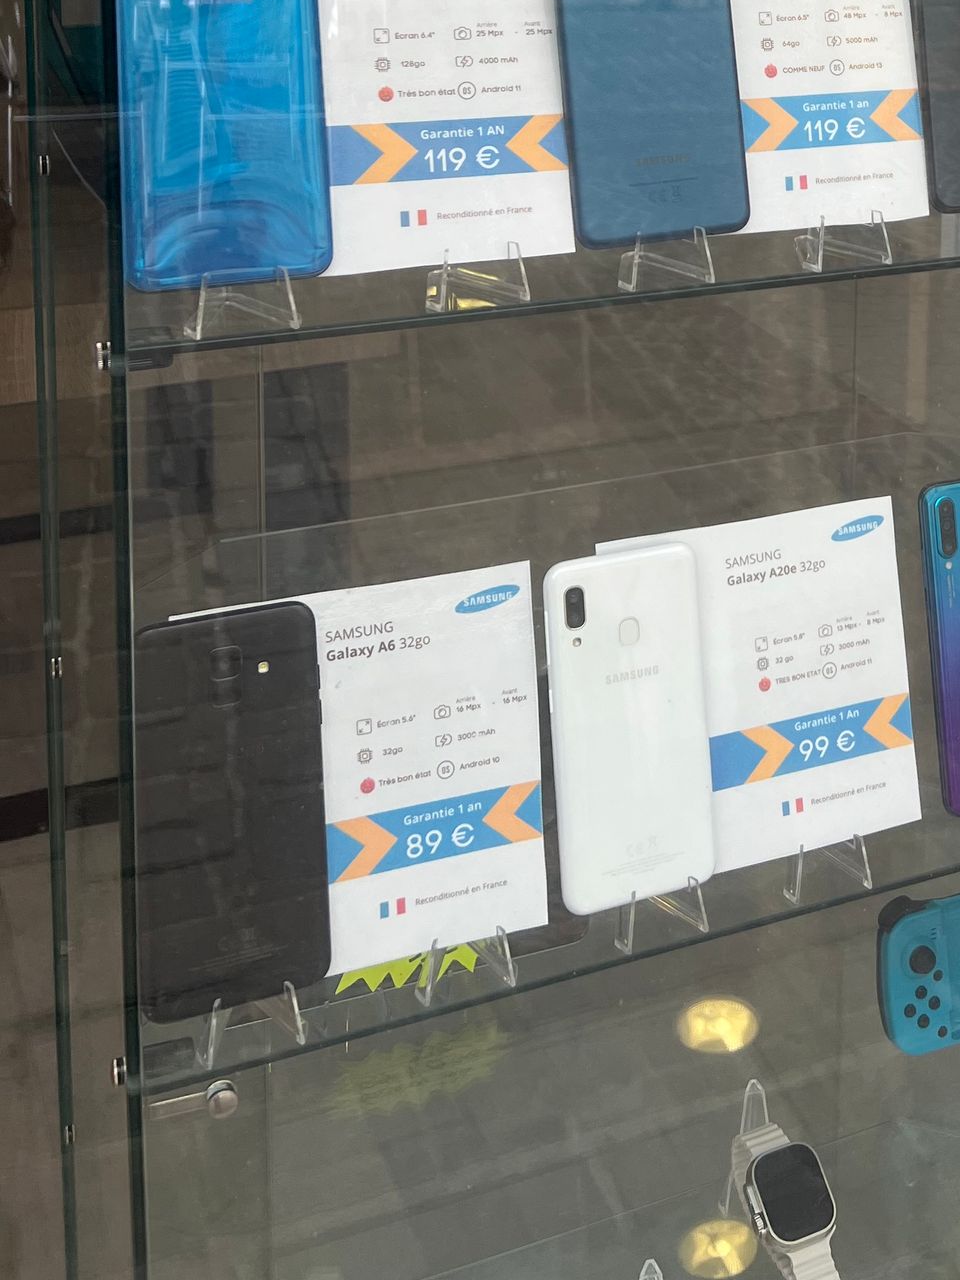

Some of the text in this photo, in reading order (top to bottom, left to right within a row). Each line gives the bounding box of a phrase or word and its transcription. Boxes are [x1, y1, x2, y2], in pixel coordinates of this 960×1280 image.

[802, 100, 869, 113] Garantie 1 an
[420, 125, 505, 140] Garantie 1 AN
[803, 117, 866, 142] 119 €
[424, 145, 500, 173] 119 €
[437, 208, 493, 220] Reconditionné
[507, 205, 533, 215] France
[838, 520, 878, 536] SAMSUNG
[725, 549, 782, 569] SAMSUNG
[727, 559, 826, 586] Galaxy A20e 32go
[463, 590, 513, 607] SAMSUNG
[325, 621, 394, 643] SAMSUNG
[326, 635, 431, 662] Galaxy A6 32go
[605, 664, 660, 686] SAMSUNG
[794, 709, 860, 731] Garantie 1 An
[382, 746, 403, 757] 32go
[798, 729, 856, 762] 99 €
[460, 756, 500, 770] Android 10
[397, 773, 414, 783] bon
[415, 769, 431, 780] état
[403, 801, 482, 826] Garantie 1 an
[406, 823, 474, 859] 89 €
[415, 879, 508, 906] Reconditionné en France
